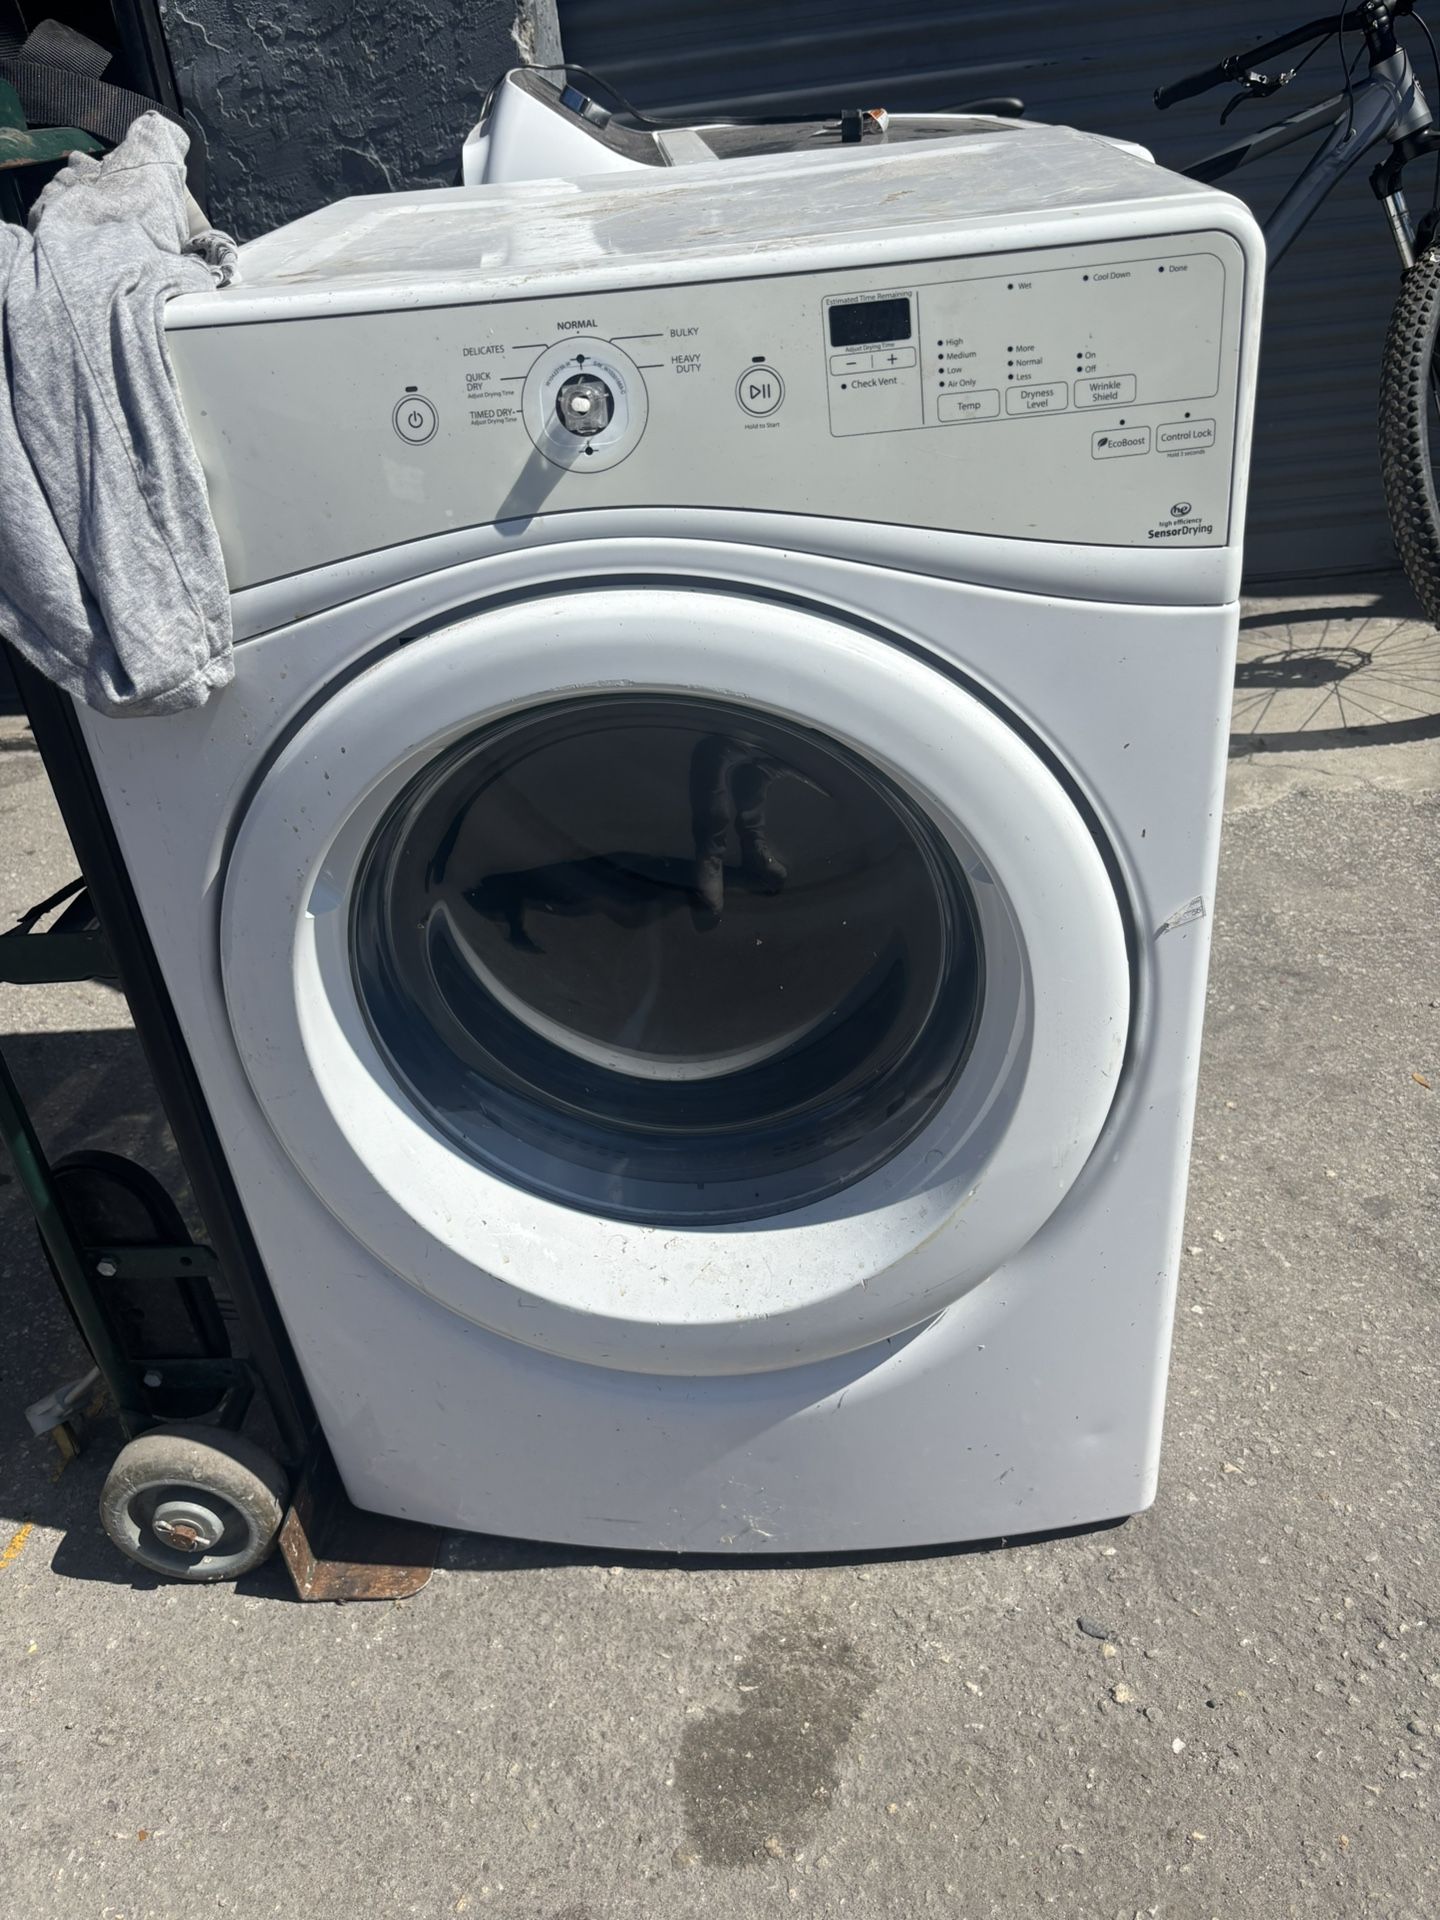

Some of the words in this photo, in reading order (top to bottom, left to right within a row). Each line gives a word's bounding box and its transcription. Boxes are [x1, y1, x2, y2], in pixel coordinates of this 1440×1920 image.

[1169, 264, 1187, 272] Done
[1093, 273, 1108, 281] Cool
[1110, 271, 1131, 279] Down
[826, 296, 858, 305] Estimated
[877, 290, 912, 299] Remaining
[557, 320, 597, 330] NORMAL
[670, 328, 699, 337] BULKY
[946, 338, 963, 347] High
[463, 345, 504, 356] DELICATES
[946, 351, 976, 360] Medium
[672, 354, 700, 364] HEAVY
[1016, 357, 1042, 366] Normal
[676, 364, 701, 373] DUTY
[1085, 365, 1096, 373] Off
[466, 372, 491, 382] QUICK
[467, 383, 482, 391] DRY
[851, 379, 877, 389] Check
[959, 378, 976, 387] Only
[1089, 381, 1121, 391] Wrinkle
[1020, 389, 1054, 400] Dryness
[1092, 392, 1118, 402] Shield
[957, 402, 981, 410] Temp
[1026, 399, 1048, 408] Level
[470, 410, 494, 418] TIMED
[1161, 430, 1191, 441] Control
[1193, 428, 1212, 438] Lock
[1108, 437, 1145, 448] EcoBoost
[1148, 524, 1212, 539] SensorDrying
